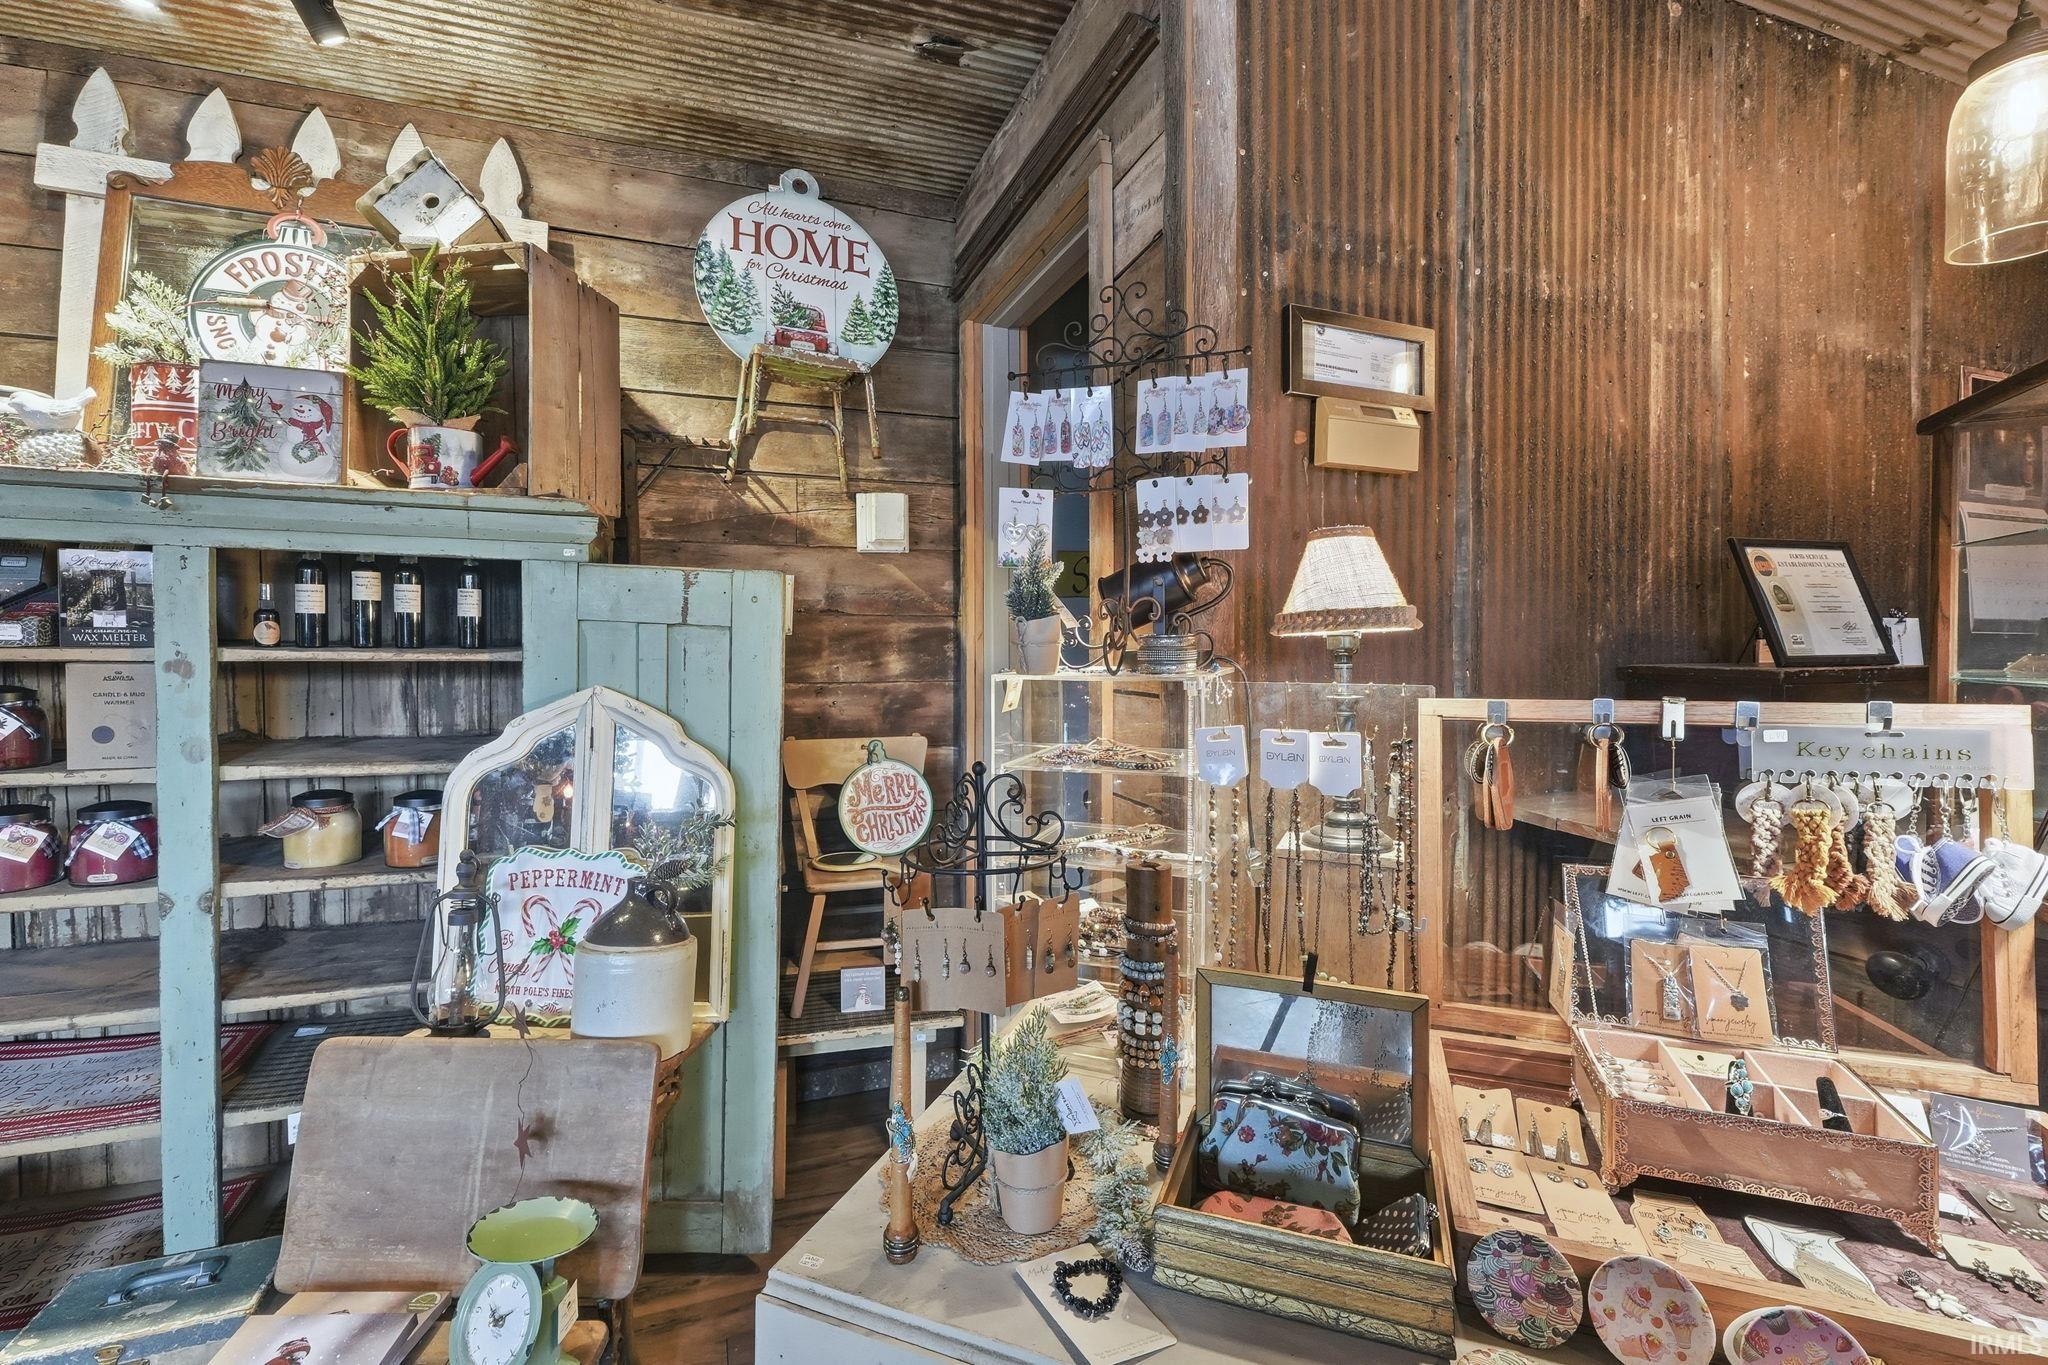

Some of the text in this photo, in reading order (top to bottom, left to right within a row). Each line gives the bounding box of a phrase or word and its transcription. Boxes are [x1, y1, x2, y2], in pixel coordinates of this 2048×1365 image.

[747, 201, 852, 232] All hearts come
[727, 212, 871, 279] HOME
[223, 250, 336, 289] FROST
[744, 258, 849, 290] for Christmas
[213, 383, 268, 409] Merry
[210, 415, 279, 449] Bright
[72, 633, 148, 642] WAX MELTER
[1795, 741, 1973, 762] Key chains
[855, 789, 928, 843] CHRISTMAS
[1668, 813, 1692, 821] GRAIN
[508, 868, 626, 897] PEPPERMINT
[494, 983, 574, 999] NRTH POLE'S FINES
